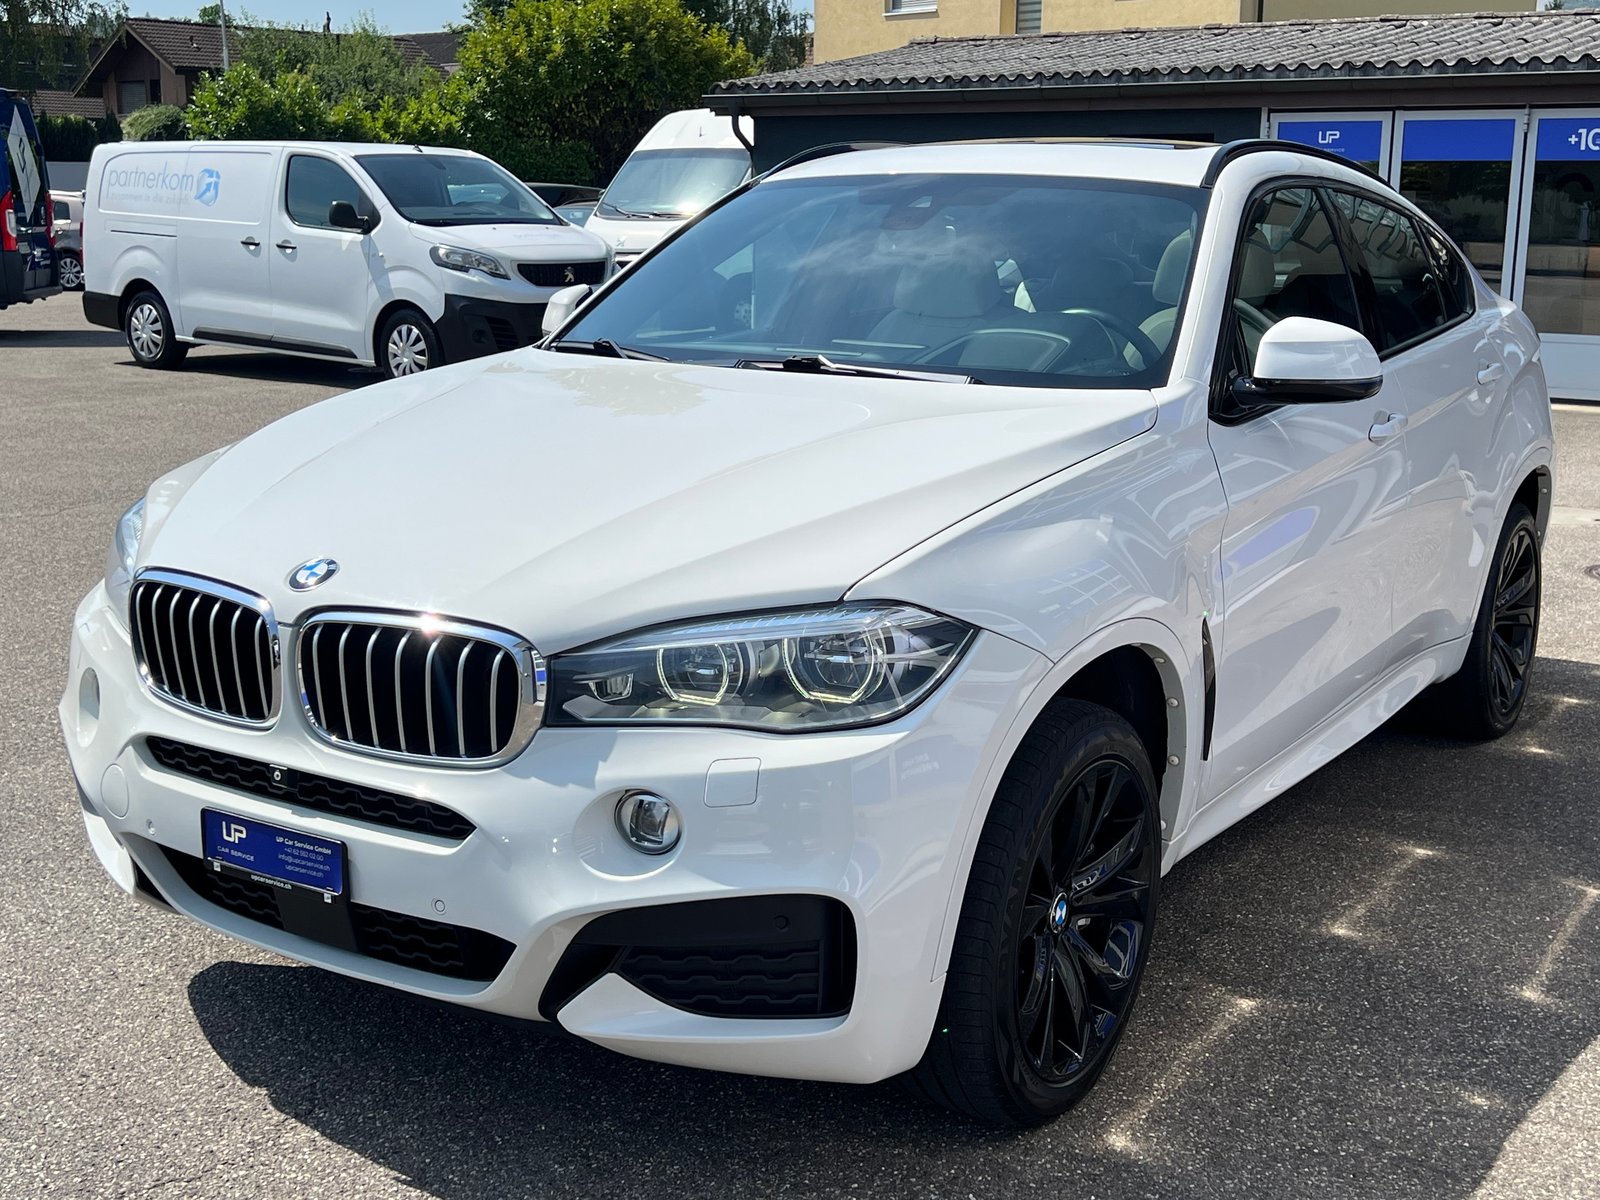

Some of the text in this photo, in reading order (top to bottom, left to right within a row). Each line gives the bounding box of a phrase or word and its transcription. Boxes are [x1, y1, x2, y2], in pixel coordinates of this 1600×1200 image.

[1318, 130, 1340, 144] UP
[106, 161, 194, 199] partnerkom
[222, 820, 247, 844] UP
[216, 845, 255, 862] CAR SERVICE
[275, 835, 332, 855] UP Car Service GmbH
[250, 874, 292, 890] upcarservice.ch
